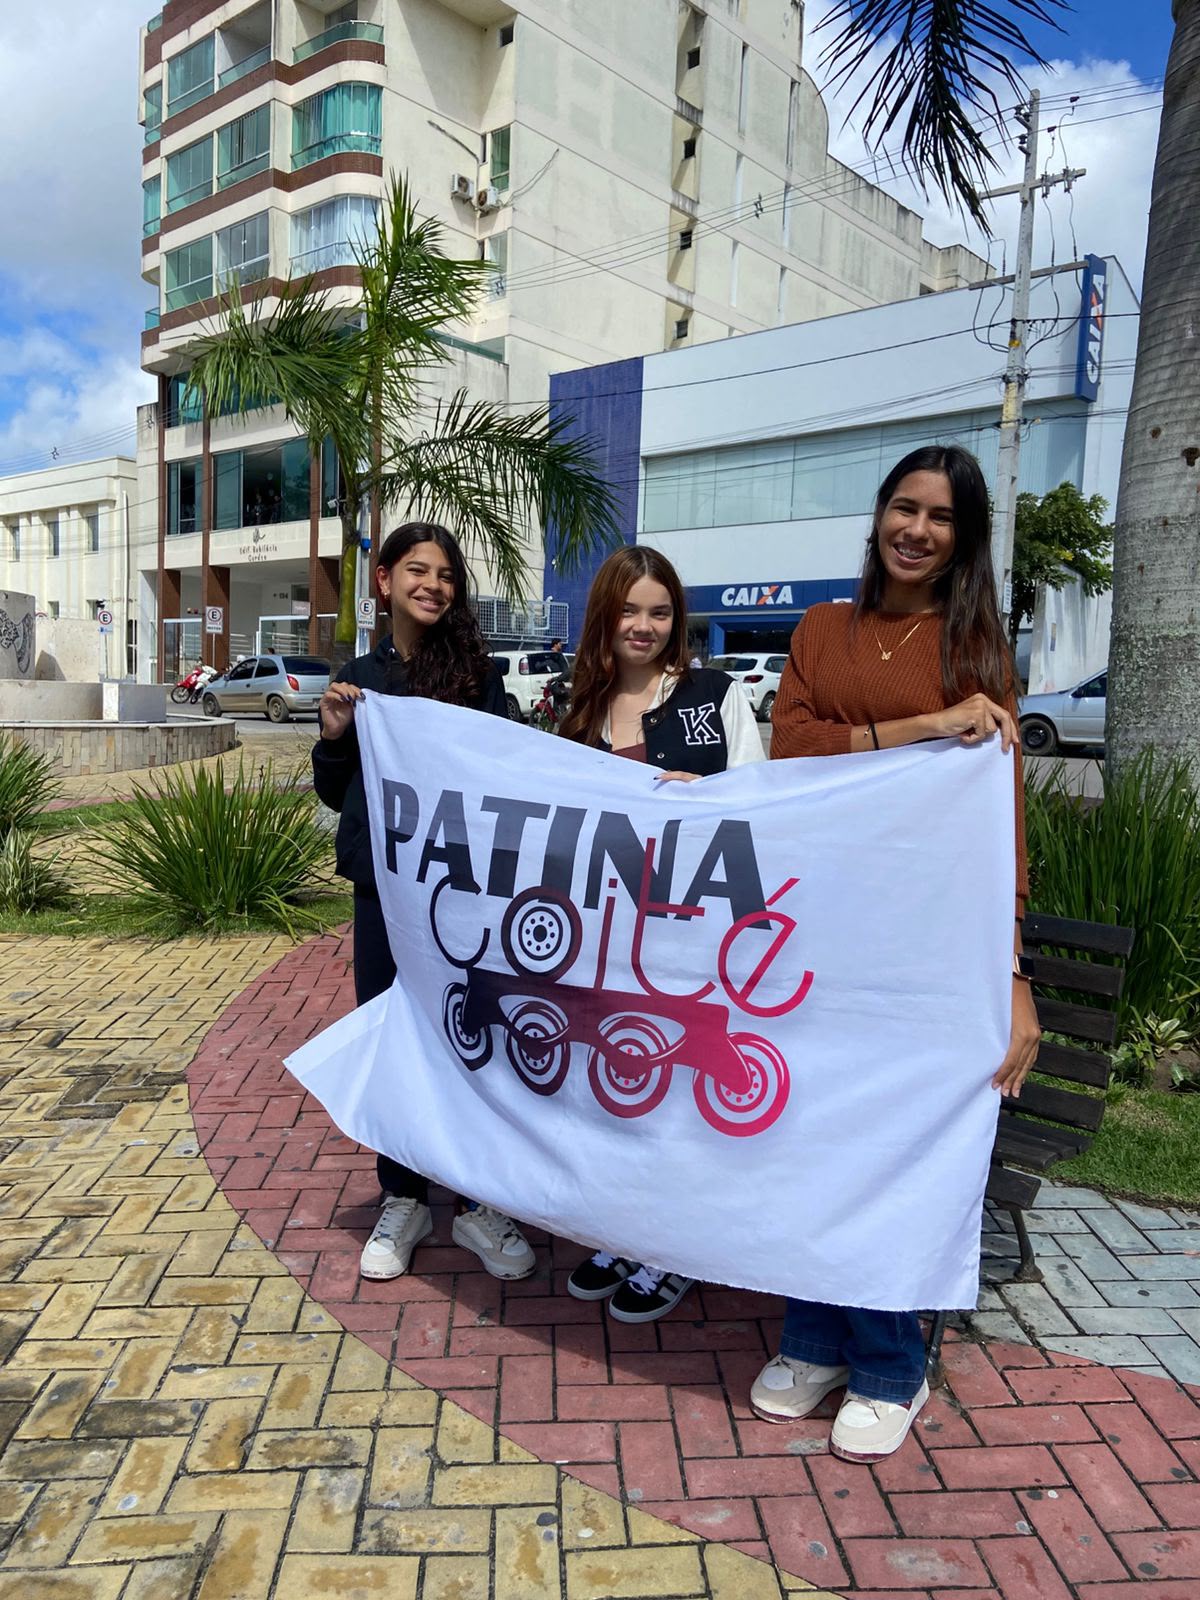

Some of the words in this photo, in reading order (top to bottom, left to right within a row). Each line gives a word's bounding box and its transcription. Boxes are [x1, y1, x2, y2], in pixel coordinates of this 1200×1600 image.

[1086, 274, 1105, 384] CAIXA
[363, 602, 370, 612] E
[721, 585, 793, 607] CAIXA
[102, 613, 108, 622] E
[211, 611, 218, 619] E
[677, 702, 721, 745] K
[382, 778, 772, 930] PATINA
